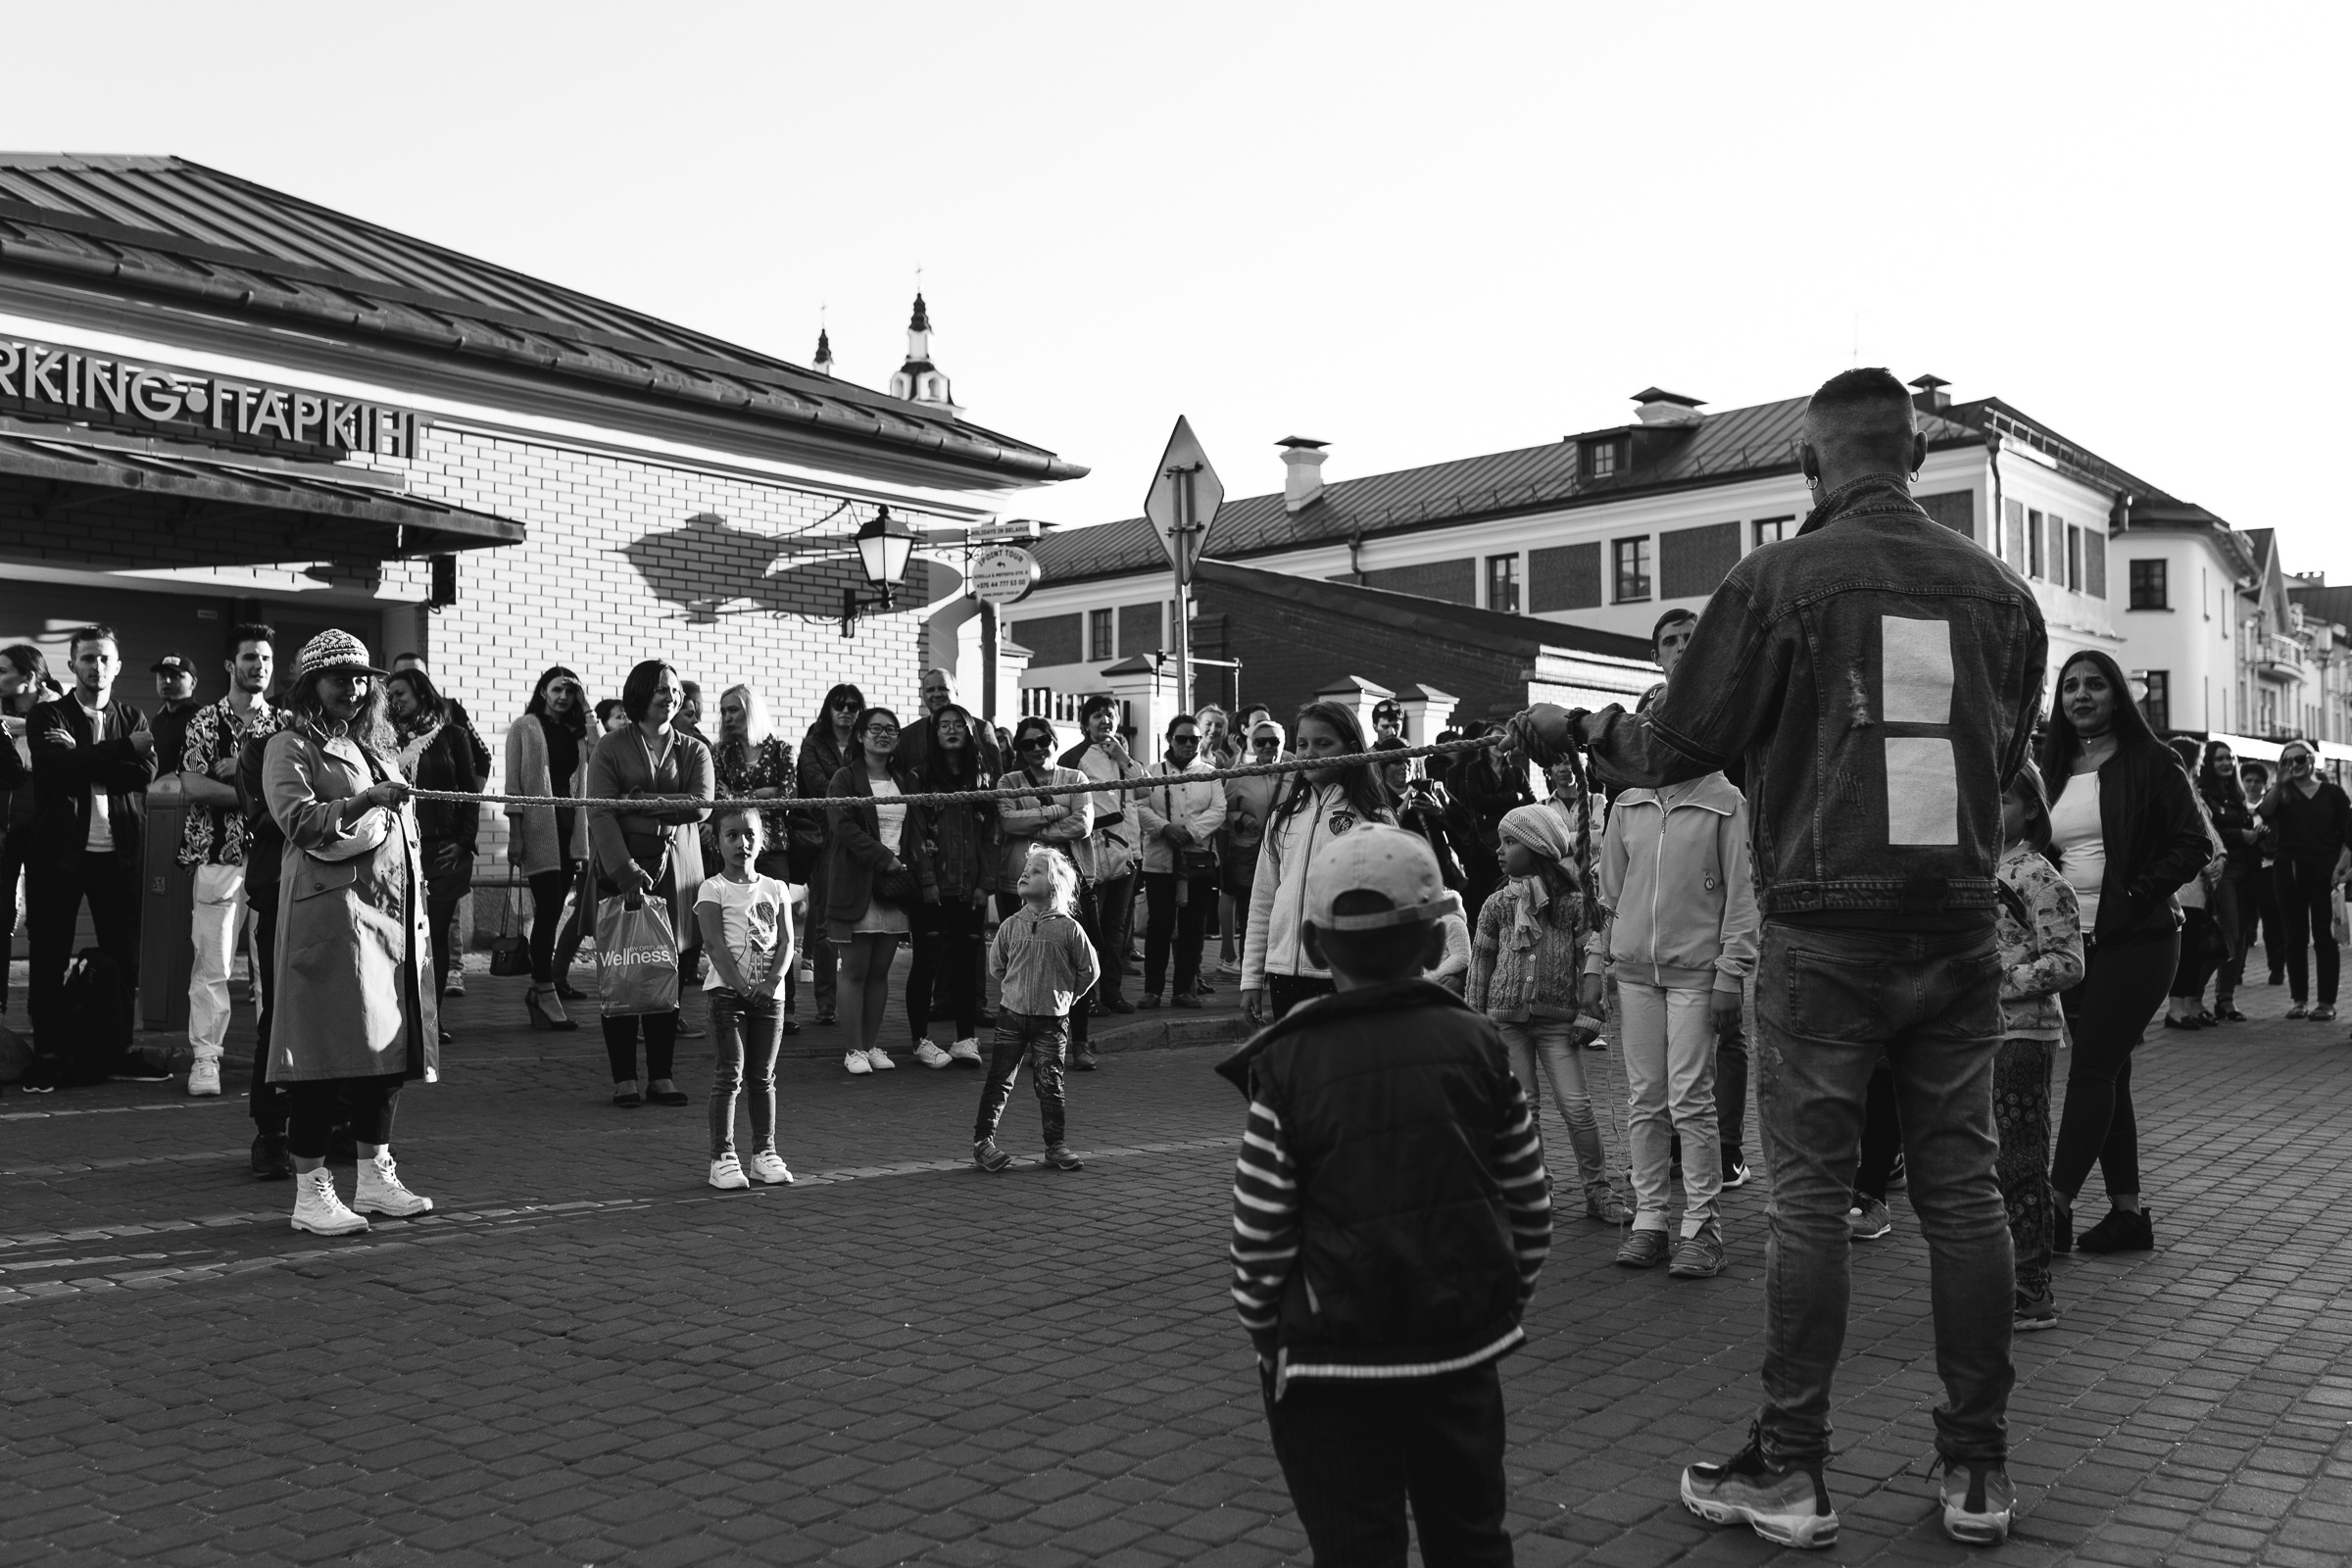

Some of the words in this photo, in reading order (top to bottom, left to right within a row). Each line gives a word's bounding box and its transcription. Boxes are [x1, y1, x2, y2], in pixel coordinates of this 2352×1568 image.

[208, 378, 435, 458] ПАРКІНГ
[1004, 549, 1024, 563] TOUR
[599, 948, 670, 967] Wellness
